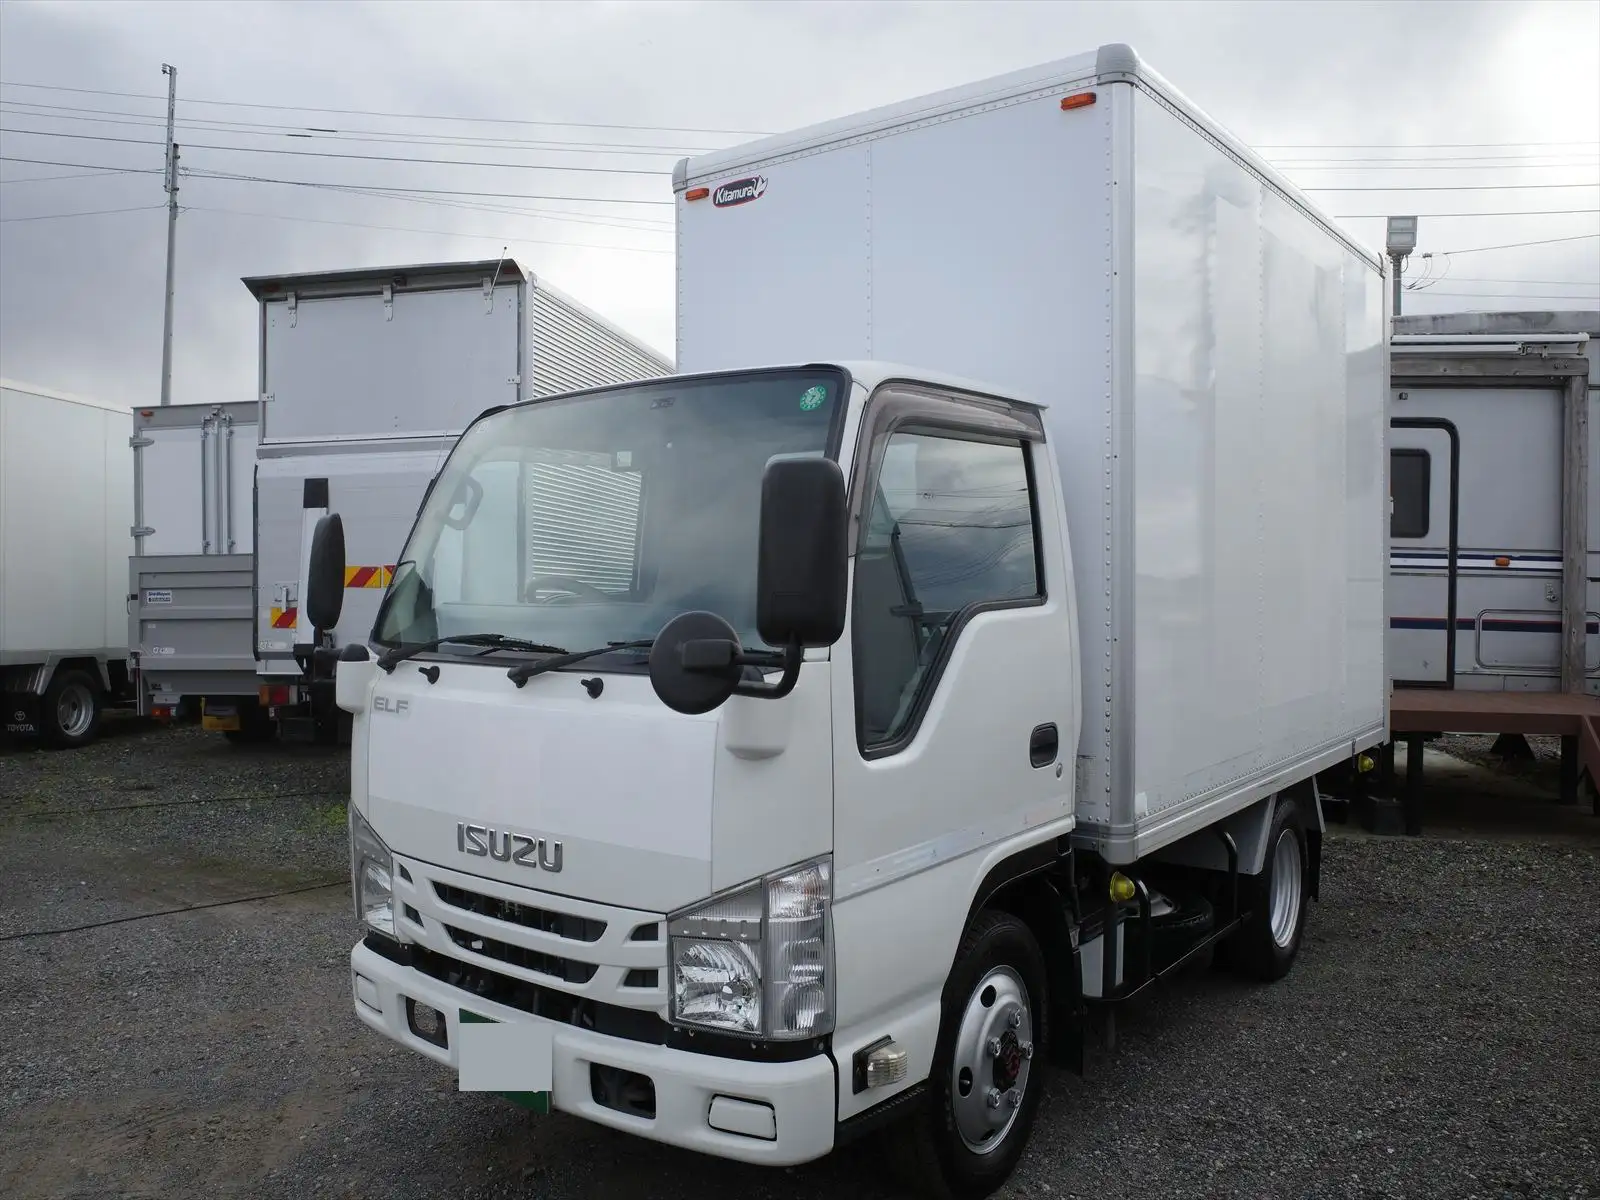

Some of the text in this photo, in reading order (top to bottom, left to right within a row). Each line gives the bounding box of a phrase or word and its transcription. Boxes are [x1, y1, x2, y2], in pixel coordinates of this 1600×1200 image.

[715, 186, 753, 204] Kitamura
[374, 696, 408, 713] ELF
[8, 723, 34, 732] TOYOTA
[457, 821, 563, 873] ISUZU
